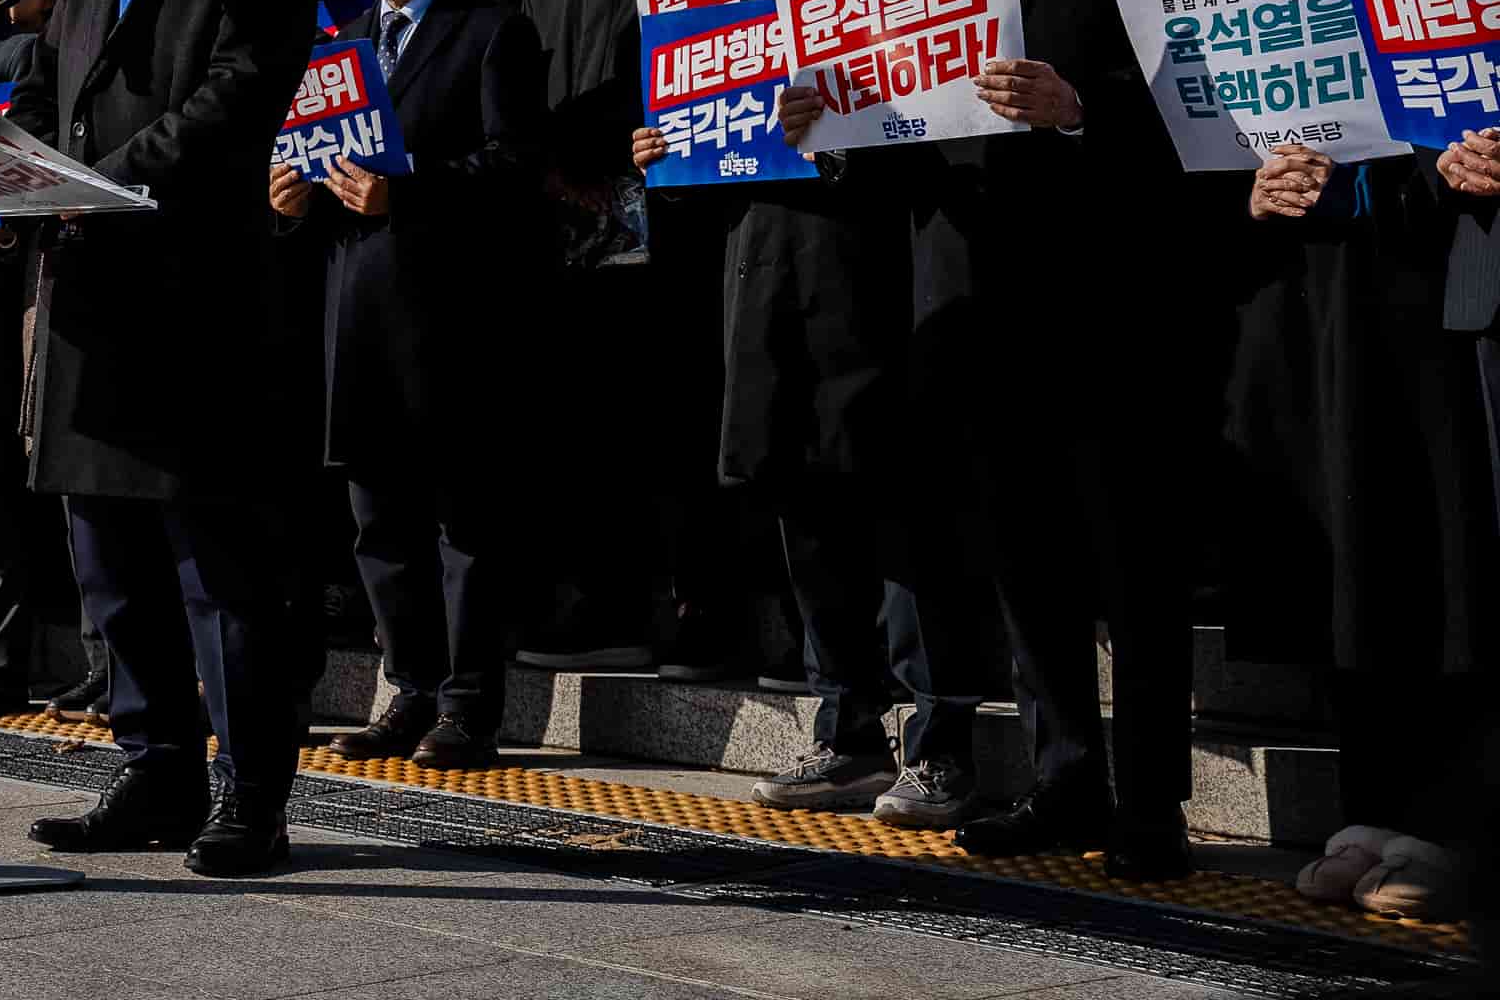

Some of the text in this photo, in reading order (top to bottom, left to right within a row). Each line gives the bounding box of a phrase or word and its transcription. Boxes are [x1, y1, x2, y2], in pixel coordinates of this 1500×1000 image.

[815, 17, 999, 116] 사퇴하라!
[1175, 50, 1367, 119] 탄핵하라
[882, 118, 927, 139] 민주당
[1250, 121, 1343, 149] 기본소득당
[719, 157, 758, 176] 민주당
